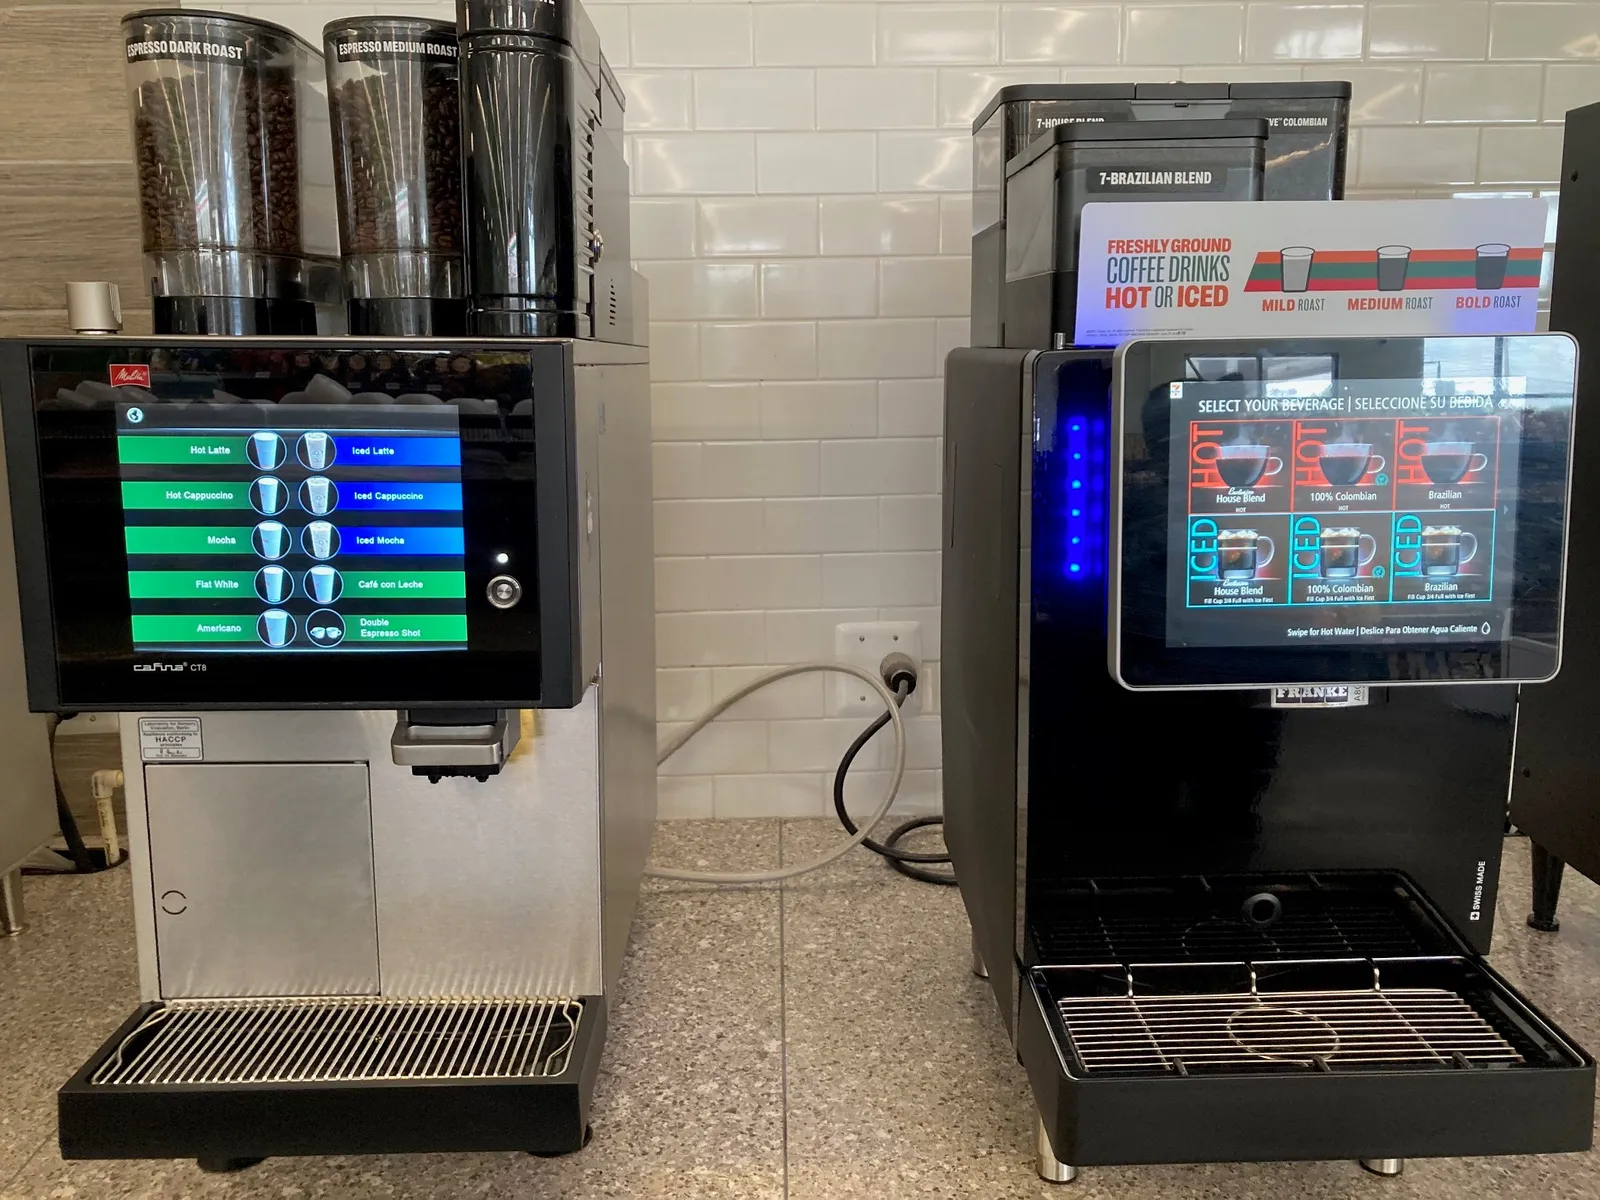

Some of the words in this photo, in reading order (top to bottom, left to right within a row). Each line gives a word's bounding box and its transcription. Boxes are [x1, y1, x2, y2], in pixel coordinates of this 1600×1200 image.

[127, 40, 167, 57] ESPRESSO
[169, 42, 201, 54] DARK
[203, 43, 243, 60] ROAST
[339, 41, 382, 55] ESPRESSO
[383, 41, 426, 54] MEDIUM
[428, 43, 458, 58] ROAST
[1283, 117, 1328, 127] COLOMBIAN
[1100, 172, 1172, 185] 7-BRAZILIAN
[1174, 171, 1212, 184] BLEND
[1107, 239, 1170, 254] FRESHLY
[1170, 237, 1232, 253] GROUND
[1106, 255, 1166, 284] COFFEE
[1168, 254, 1230, 283] DRINKS
[1105, 286, 1152, 309] HOT
[1154, 285, 1173, 308] OR
[1176, 284, 1229, 308] ICED
[1456, 296, 1491, 309] BOLD
[1493, 295, 1522, 309] ROAST
[1262, 299, 1295, 312] MILD
[1297, 298, 1326, 312] ROAST
[1347, 297, 1403, 311] MEDIUM
[1404, 296, 1433, 310] ROAST
[1198, 400, 1241, 413] SELECT
[1244, 399, 1279, 412] YOUR
[1281, 397, 1344, 411] BEVERAGE
[1354, 396, 1427, 410] SELECCIONE
[1430, 396, 1446, 409] SU
[1450, 394, 1494, 409] BEBIDA
[190, 445, 206, 454] Hot
[208, 445, 231, 454] Latte
[352, 446, 370, 455] Iced
[373, 446, 395, 455] Latte
[1192, 423, 1225, 488] HOT
[1295, 422, 1328, 486] HOT
[1397, 420, 1430, 484] HOT
[165, 491, 181, 499] Hot
[183, 491, 234, 501] Cappuccino
[354, 492, 372, 500] Iced
[375, 492, 424, 502] Cappuccino
[1216, 495, 1242, 503] House
[1244, 493, 1265, 502] Blend
[1310, 492, 1333, 501] 100%
[1335, 491, 1377, 500] Colombian
[1428, 489, 1462, 499] Brazilian
[207, 536, 236, 544] Mocha
[356, 536, 374, 545] Iced
[377, 536, 405, 545] Mocha
[1394, 514, 1422, 577] ICED
[1190, 518, 1218, 581] ICED
[1293, 516, 1320, 579] ICED
[195, 580, 212, 589] Flat
[214, 580, 239, 589] White
[358, 580, 378, 589] Café
[398, 580, 424, 589] Leche
[1214, 587, 1239, 596] House
[1241, 586, 1264, 595] Blend
[1308, 585, 1330, 594] 100%
[1333, 584, 1374, 593] Colombian
[1425, 582, 1458, 591] Brazilian
[197, 624, 241, 632] Americano
[360, 618, 390, 627] Double
[360, 629, 399, 638] Espresso
[401, 629, 421, 637] Shot
[1287, 628, 1308, 637] Swipe
[1309, 627, 1320, 636] for
[1320, 627, 1333, 636] Hot
[1334, 626, 1355, 635] Water
[1360, 626, 1384, 635] Deslice
[1385, 626, 1401, 635] Para
[1402, 625, 1429, 634] Obtener
[1430, 625, 1449, 635] Agua
[1450, 624, 1478, 633] Caliente
[190, 663, 207, 672] CT8
[1277, 685, 1348, 698] FRANKE
[1476, 861, 1486, 884] MADE
[1472, 885, 1483, 910] SWISS
